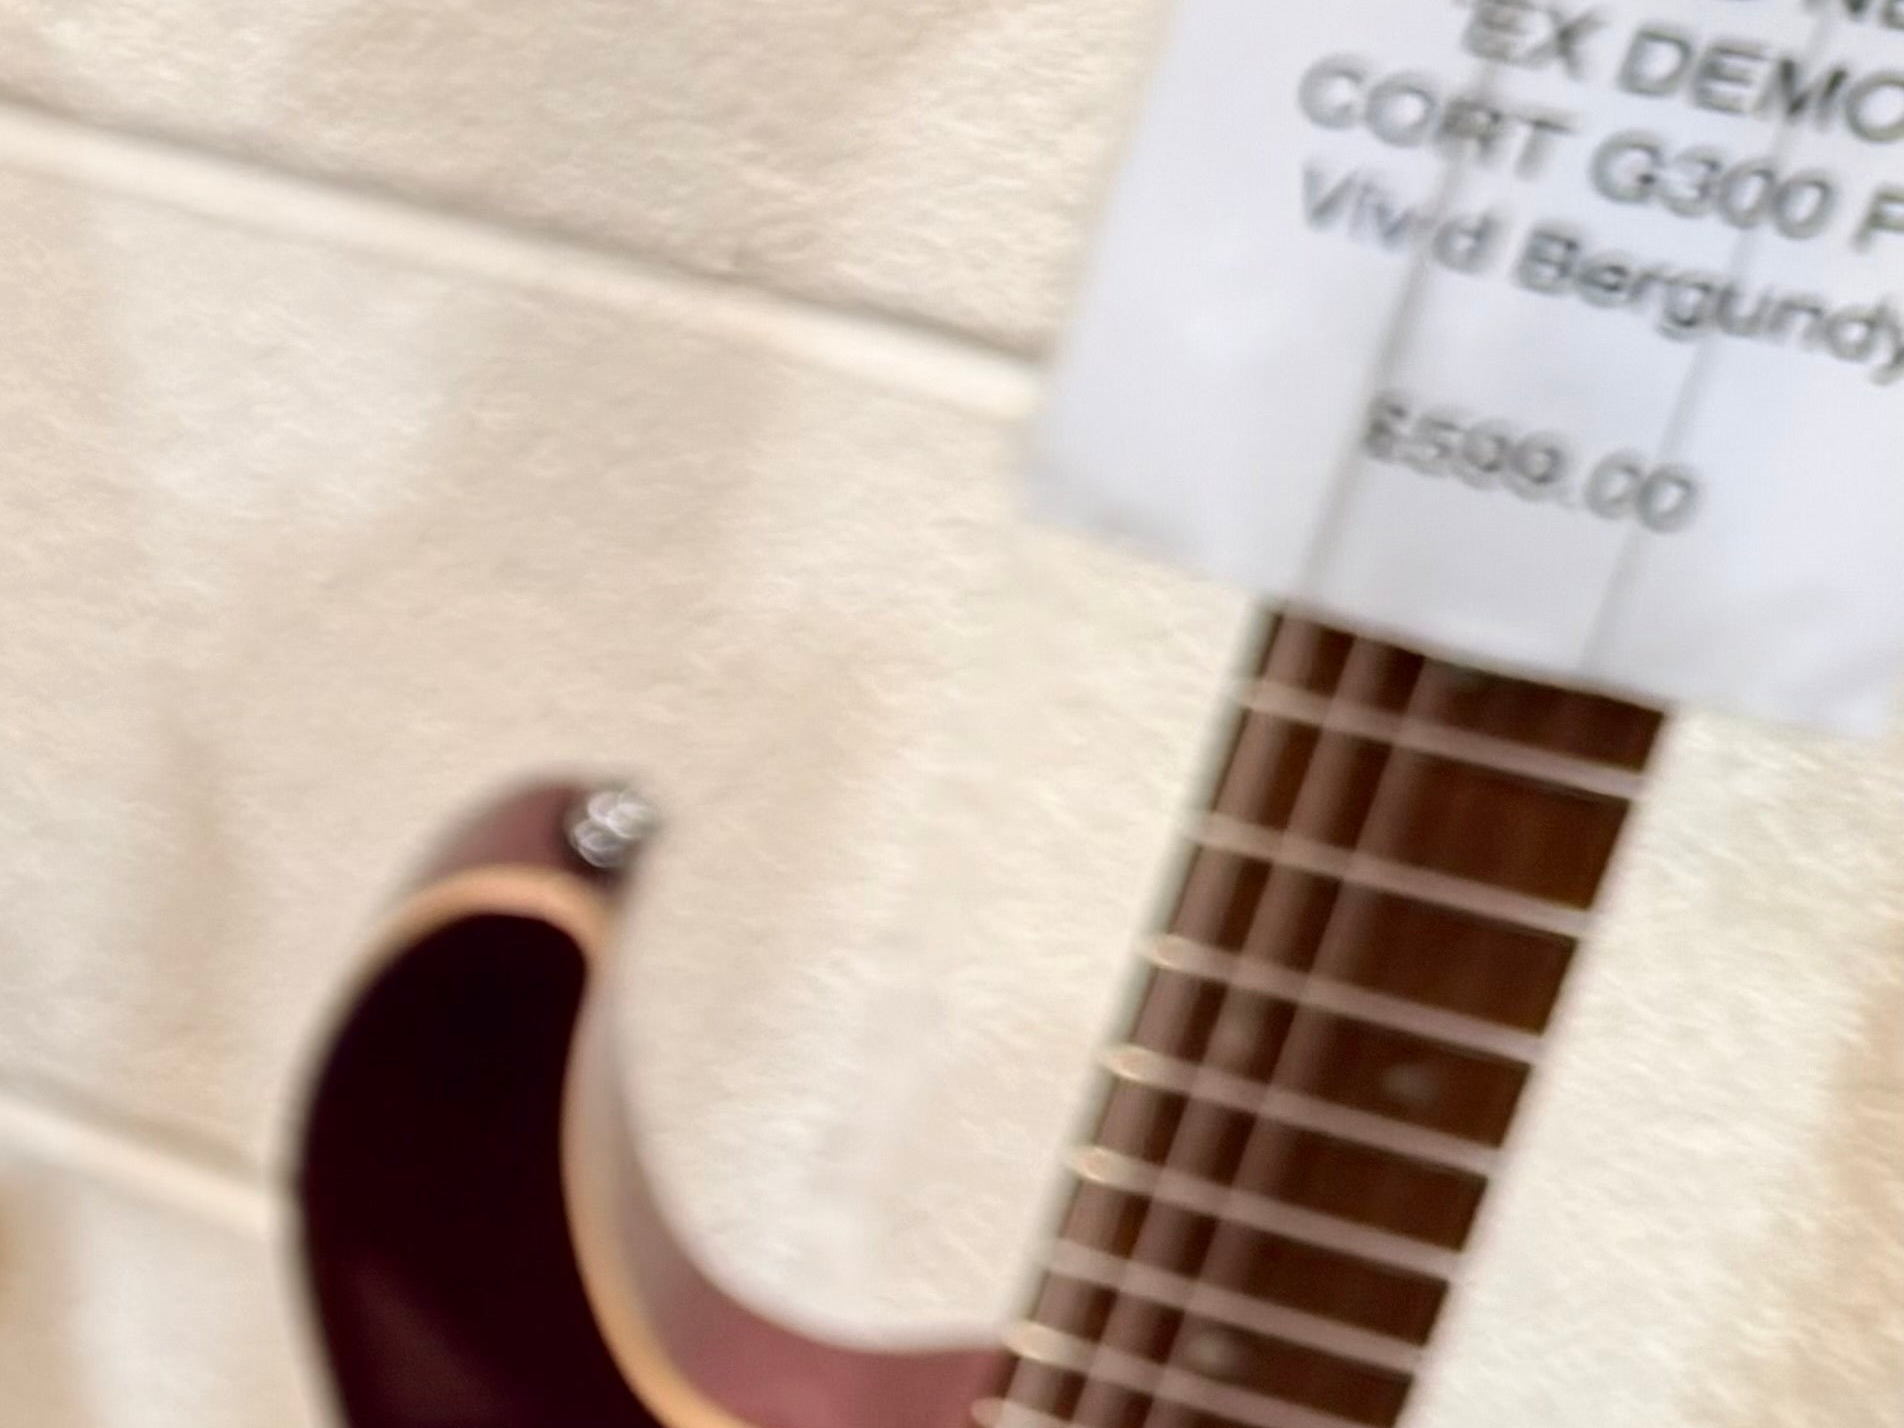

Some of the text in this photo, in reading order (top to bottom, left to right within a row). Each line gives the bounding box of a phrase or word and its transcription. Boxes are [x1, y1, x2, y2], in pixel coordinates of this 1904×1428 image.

[1294, 48, 1580, 180] CORT
[1588, 128, 1838, 242] G300
[1616, 22, 1904, 146] DEMO
[1298, 158, 1504, 276] Vivd
